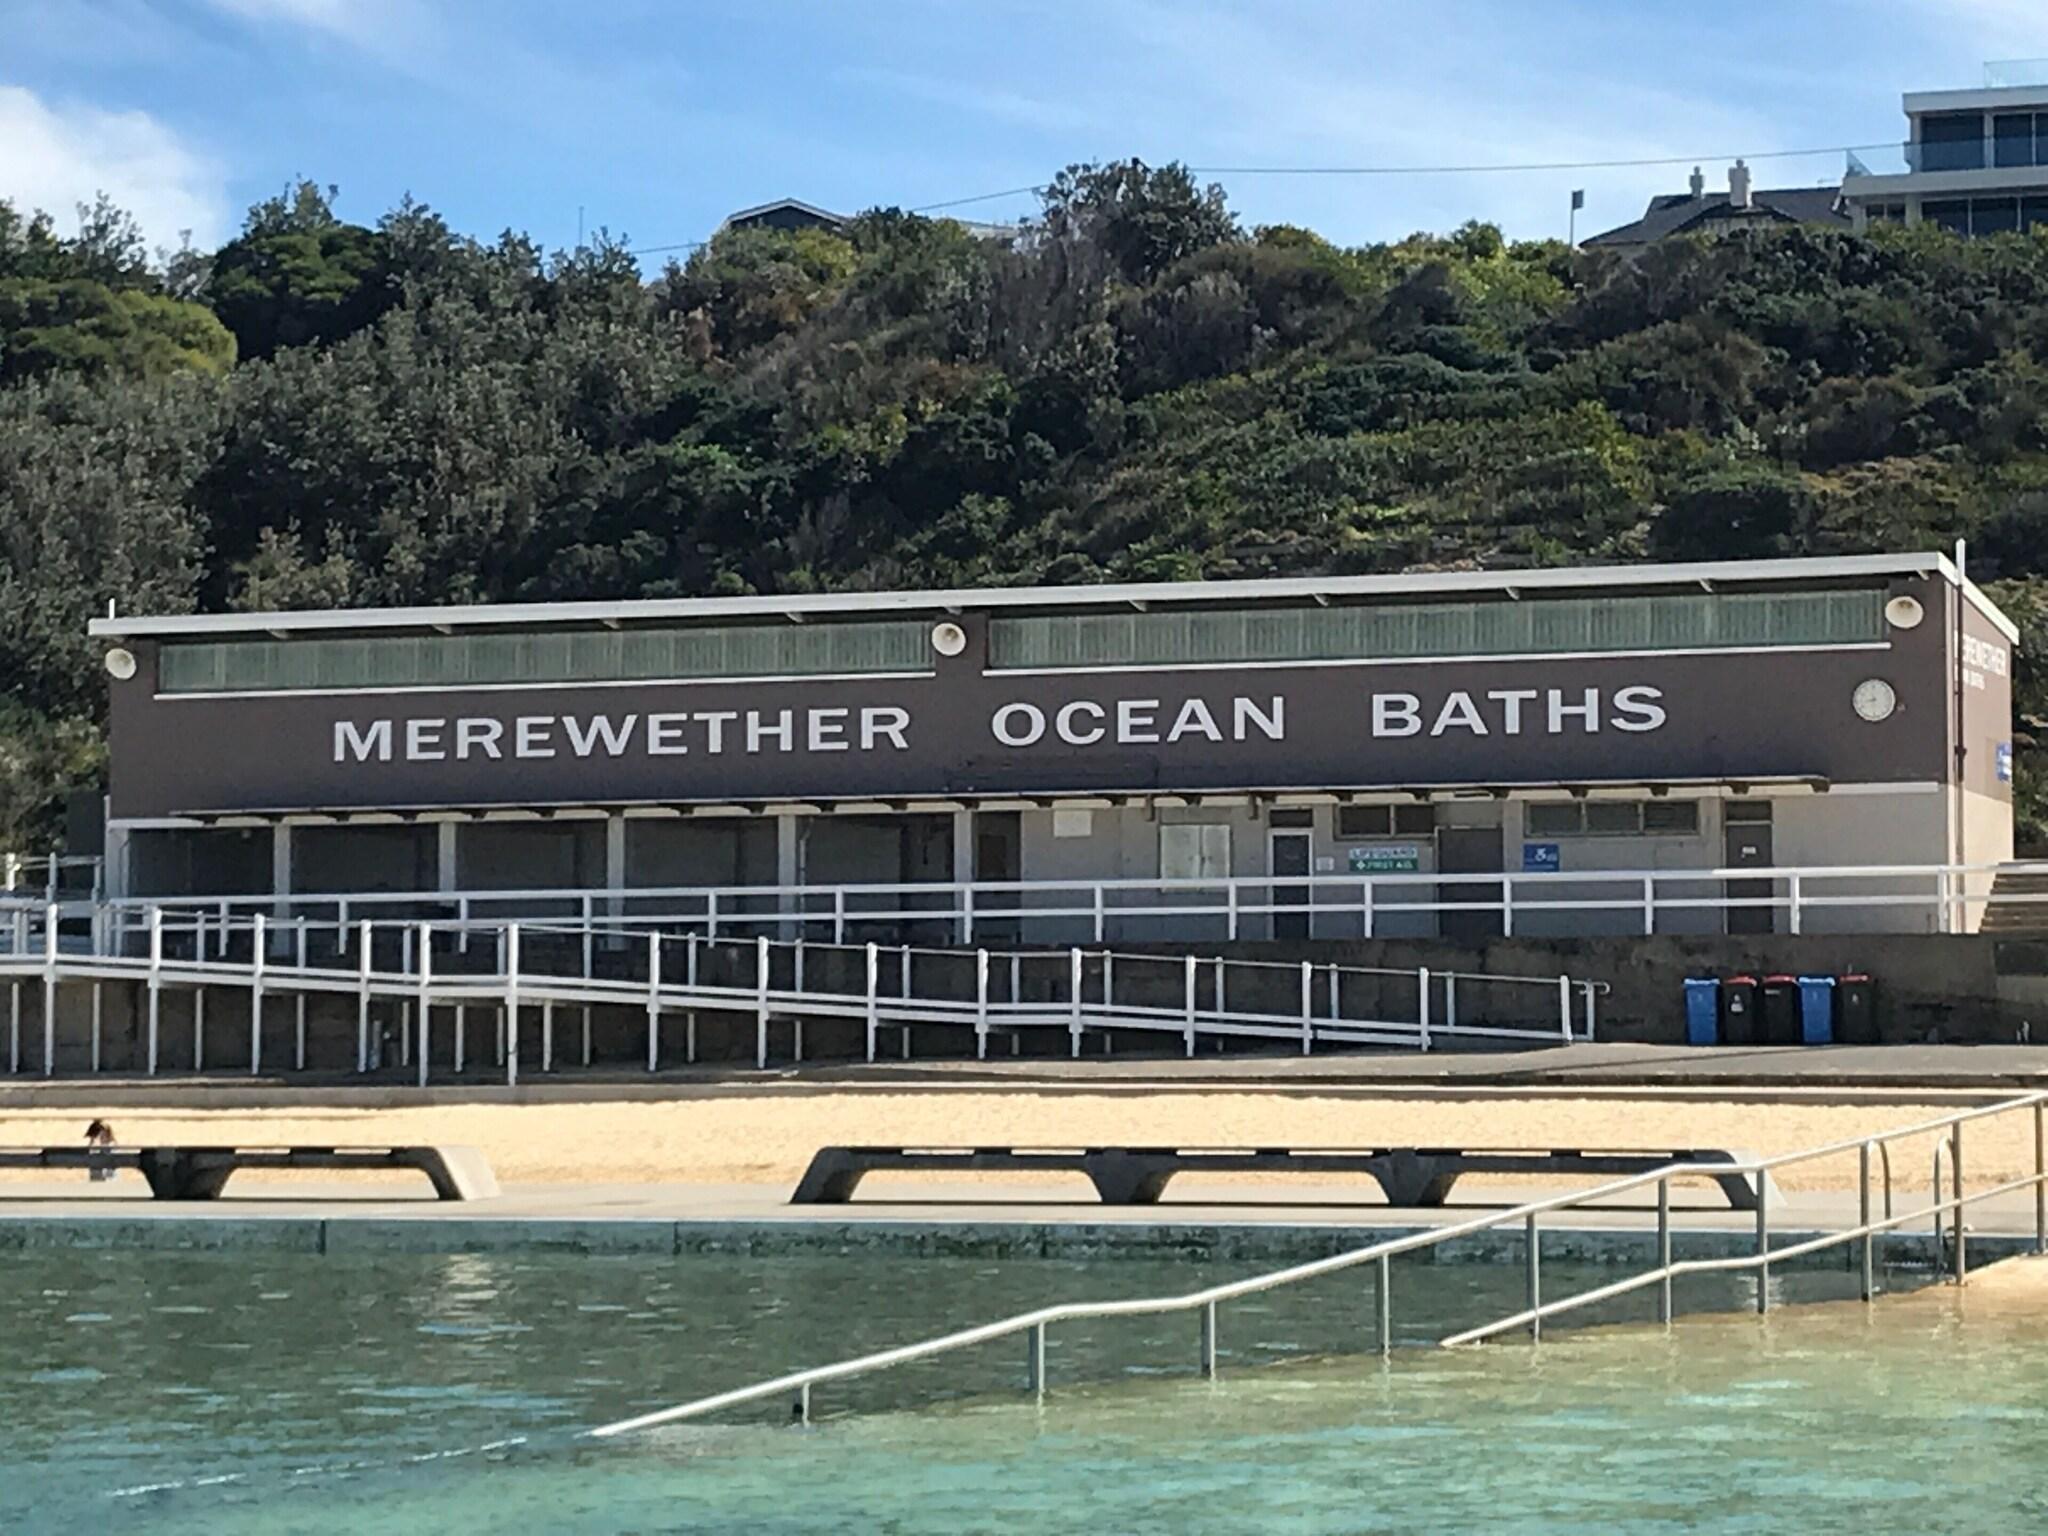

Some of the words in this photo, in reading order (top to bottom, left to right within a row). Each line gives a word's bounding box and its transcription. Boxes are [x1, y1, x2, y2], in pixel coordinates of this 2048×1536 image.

[334, 706, 911, 762] MEREWETHER
[991, 695, 1287, 747] OCEAN
[1372, 686, 1667, 737] BATHS
